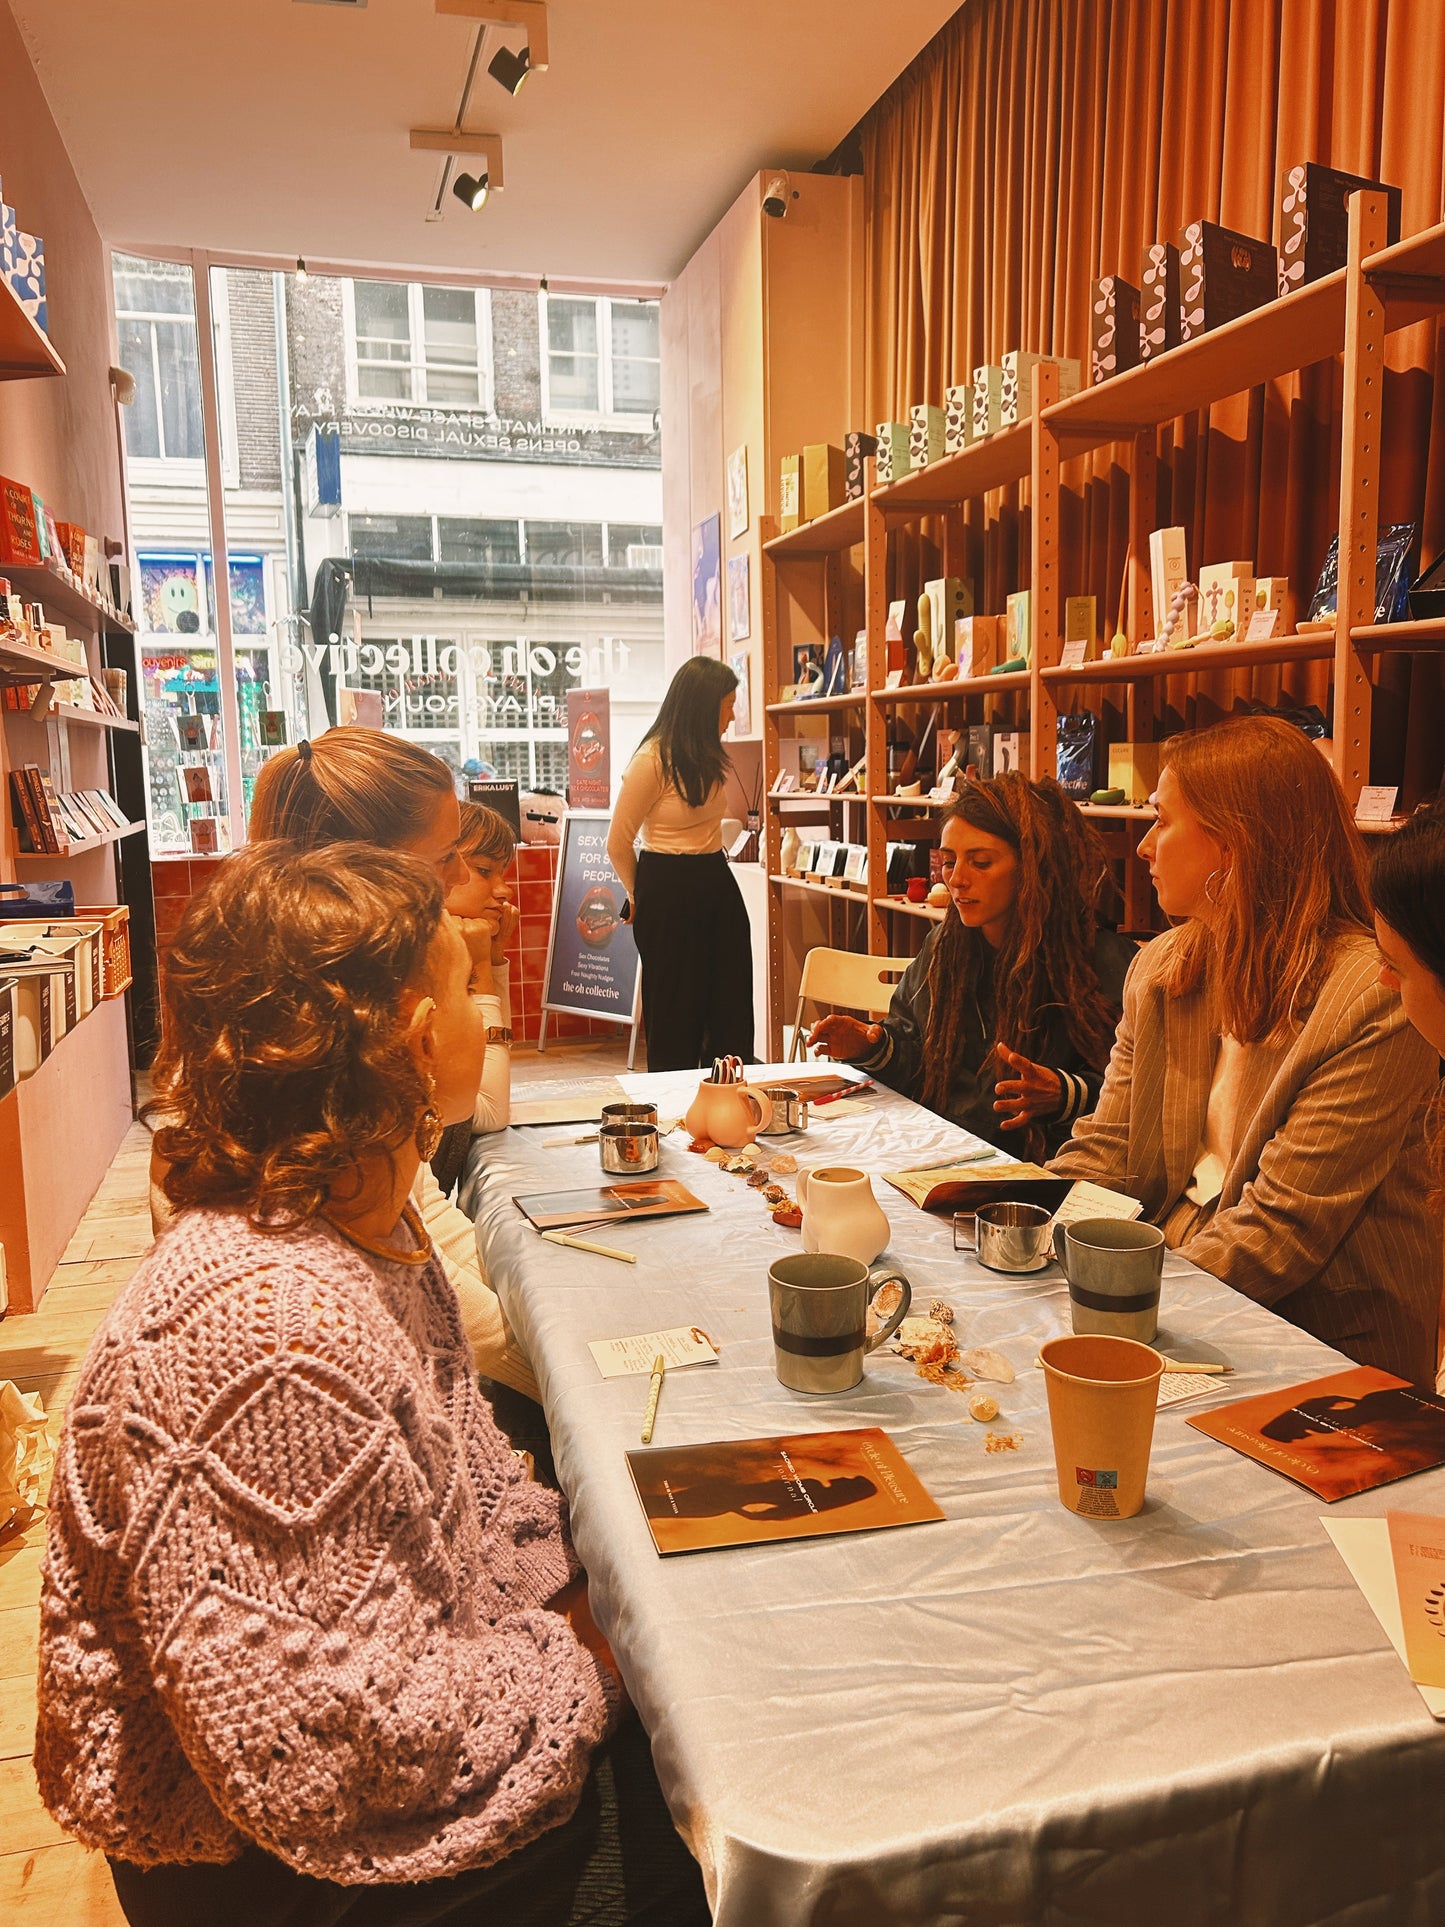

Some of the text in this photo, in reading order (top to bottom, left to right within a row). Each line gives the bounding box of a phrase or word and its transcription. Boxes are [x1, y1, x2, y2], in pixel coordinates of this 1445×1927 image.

[8, 510, 34, 529] THORNS
[142, 655, 188, 668] ouvenirs
[578, 836, 607, 847] SEXY
[580, 853, 601, 864] FOR
[563, 981, 620, 999] the oh collective
[780, 1451, 819, 1513] SACRED WOMB CIRCLE
[880, 1470, 909, 1504] Pleasure
